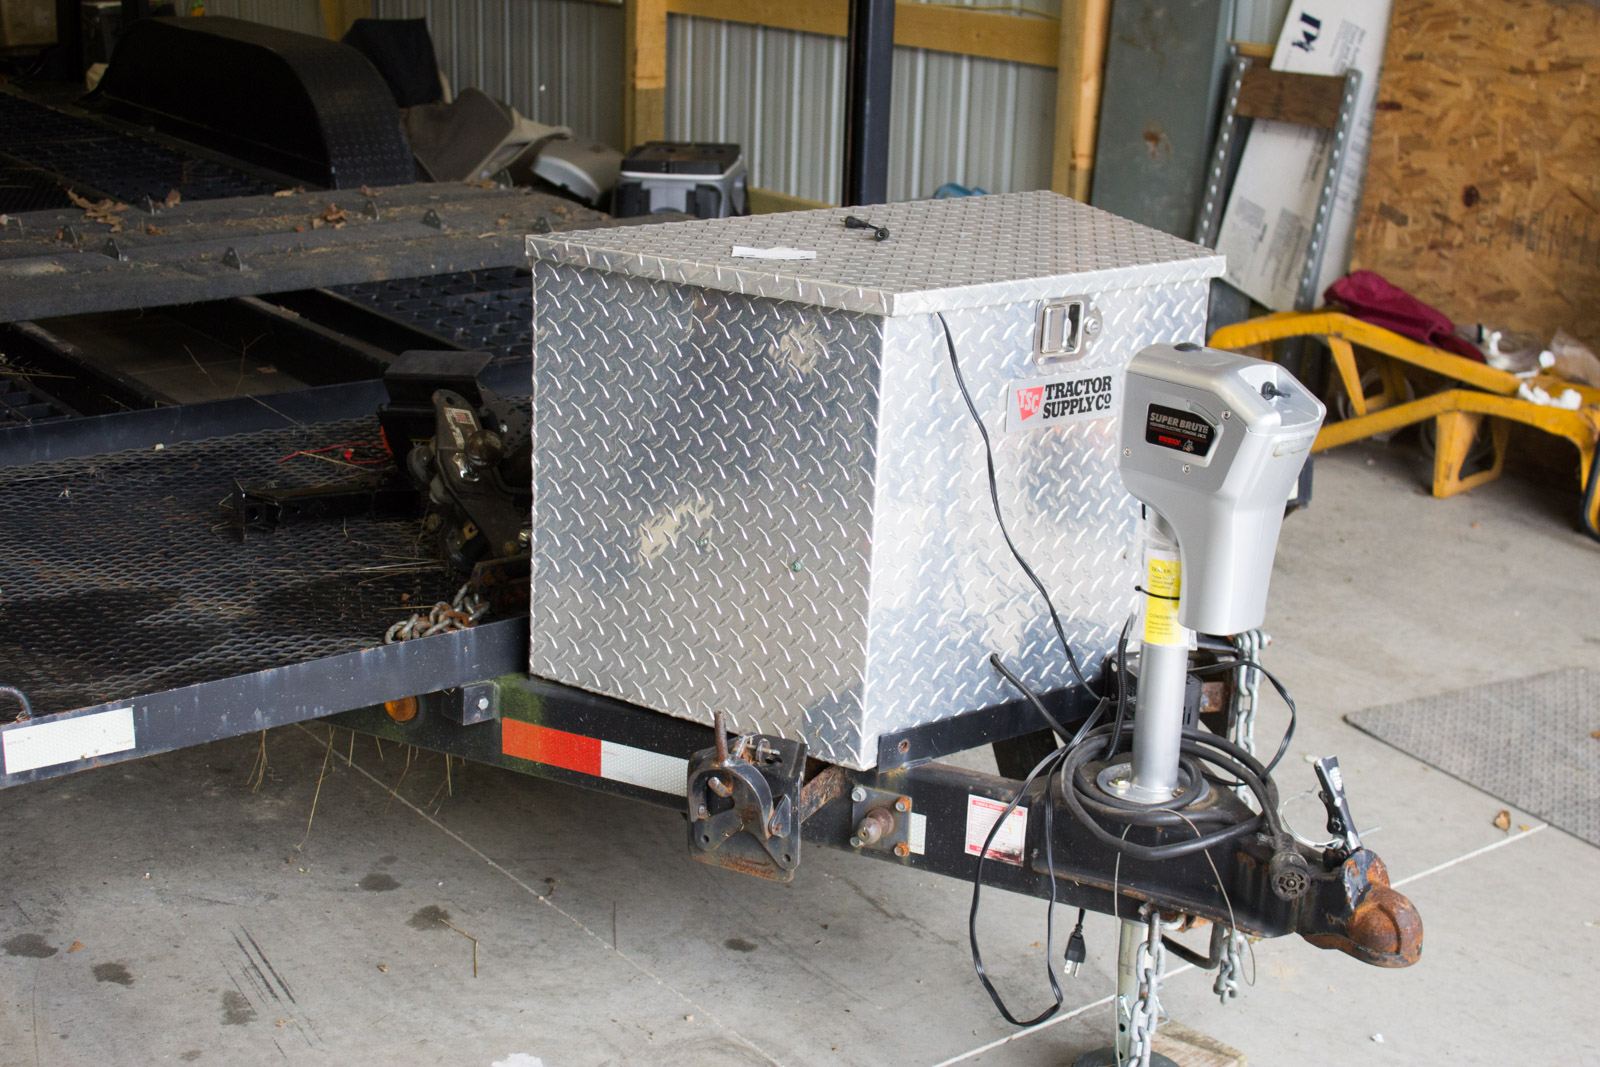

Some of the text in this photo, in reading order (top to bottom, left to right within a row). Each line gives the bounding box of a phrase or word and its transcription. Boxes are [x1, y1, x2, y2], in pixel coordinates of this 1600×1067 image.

[1045, 375, 1112, 400] TRACTOR
[1018, 389, 1039, 413] TSC
[1043, 396, 1095, 419] SUPPLY
[1149, 412, 1179, 426] SUPER
[1179, 419, 1209, 434] BRUTE
